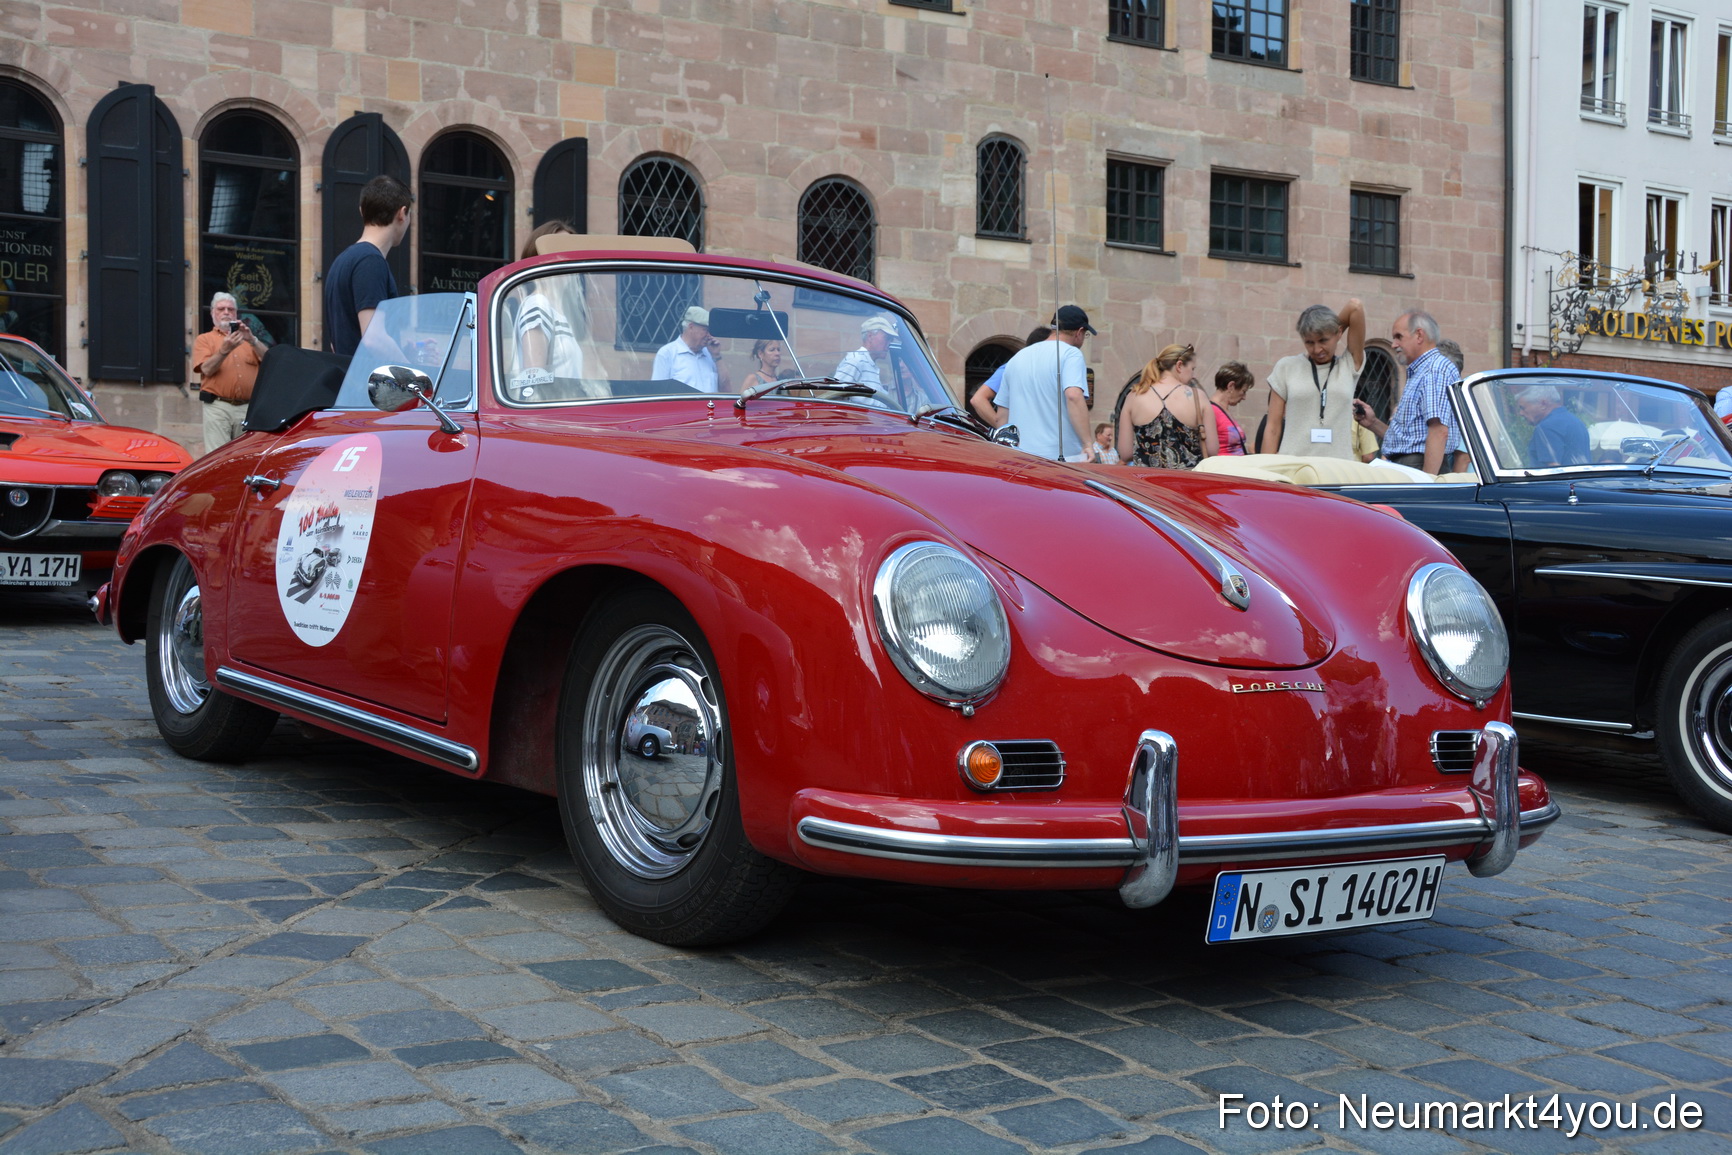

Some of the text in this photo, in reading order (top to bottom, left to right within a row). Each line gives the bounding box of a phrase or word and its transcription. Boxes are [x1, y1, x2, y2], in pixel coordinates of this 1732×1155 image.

[235, 252, 265, 261] Weidler
[0, 260, 49, 283] DLER
[240, 272, 259, 282] seit
[1586, 306, 1706, 346] GOLDENES
[332, 446, 369, 472] 15
[38, 557, 79, 578] 17H
[1232, 681, 1326, 694] PORSCHE
[1216, 865, 1442, 933] D N SI 1402H
